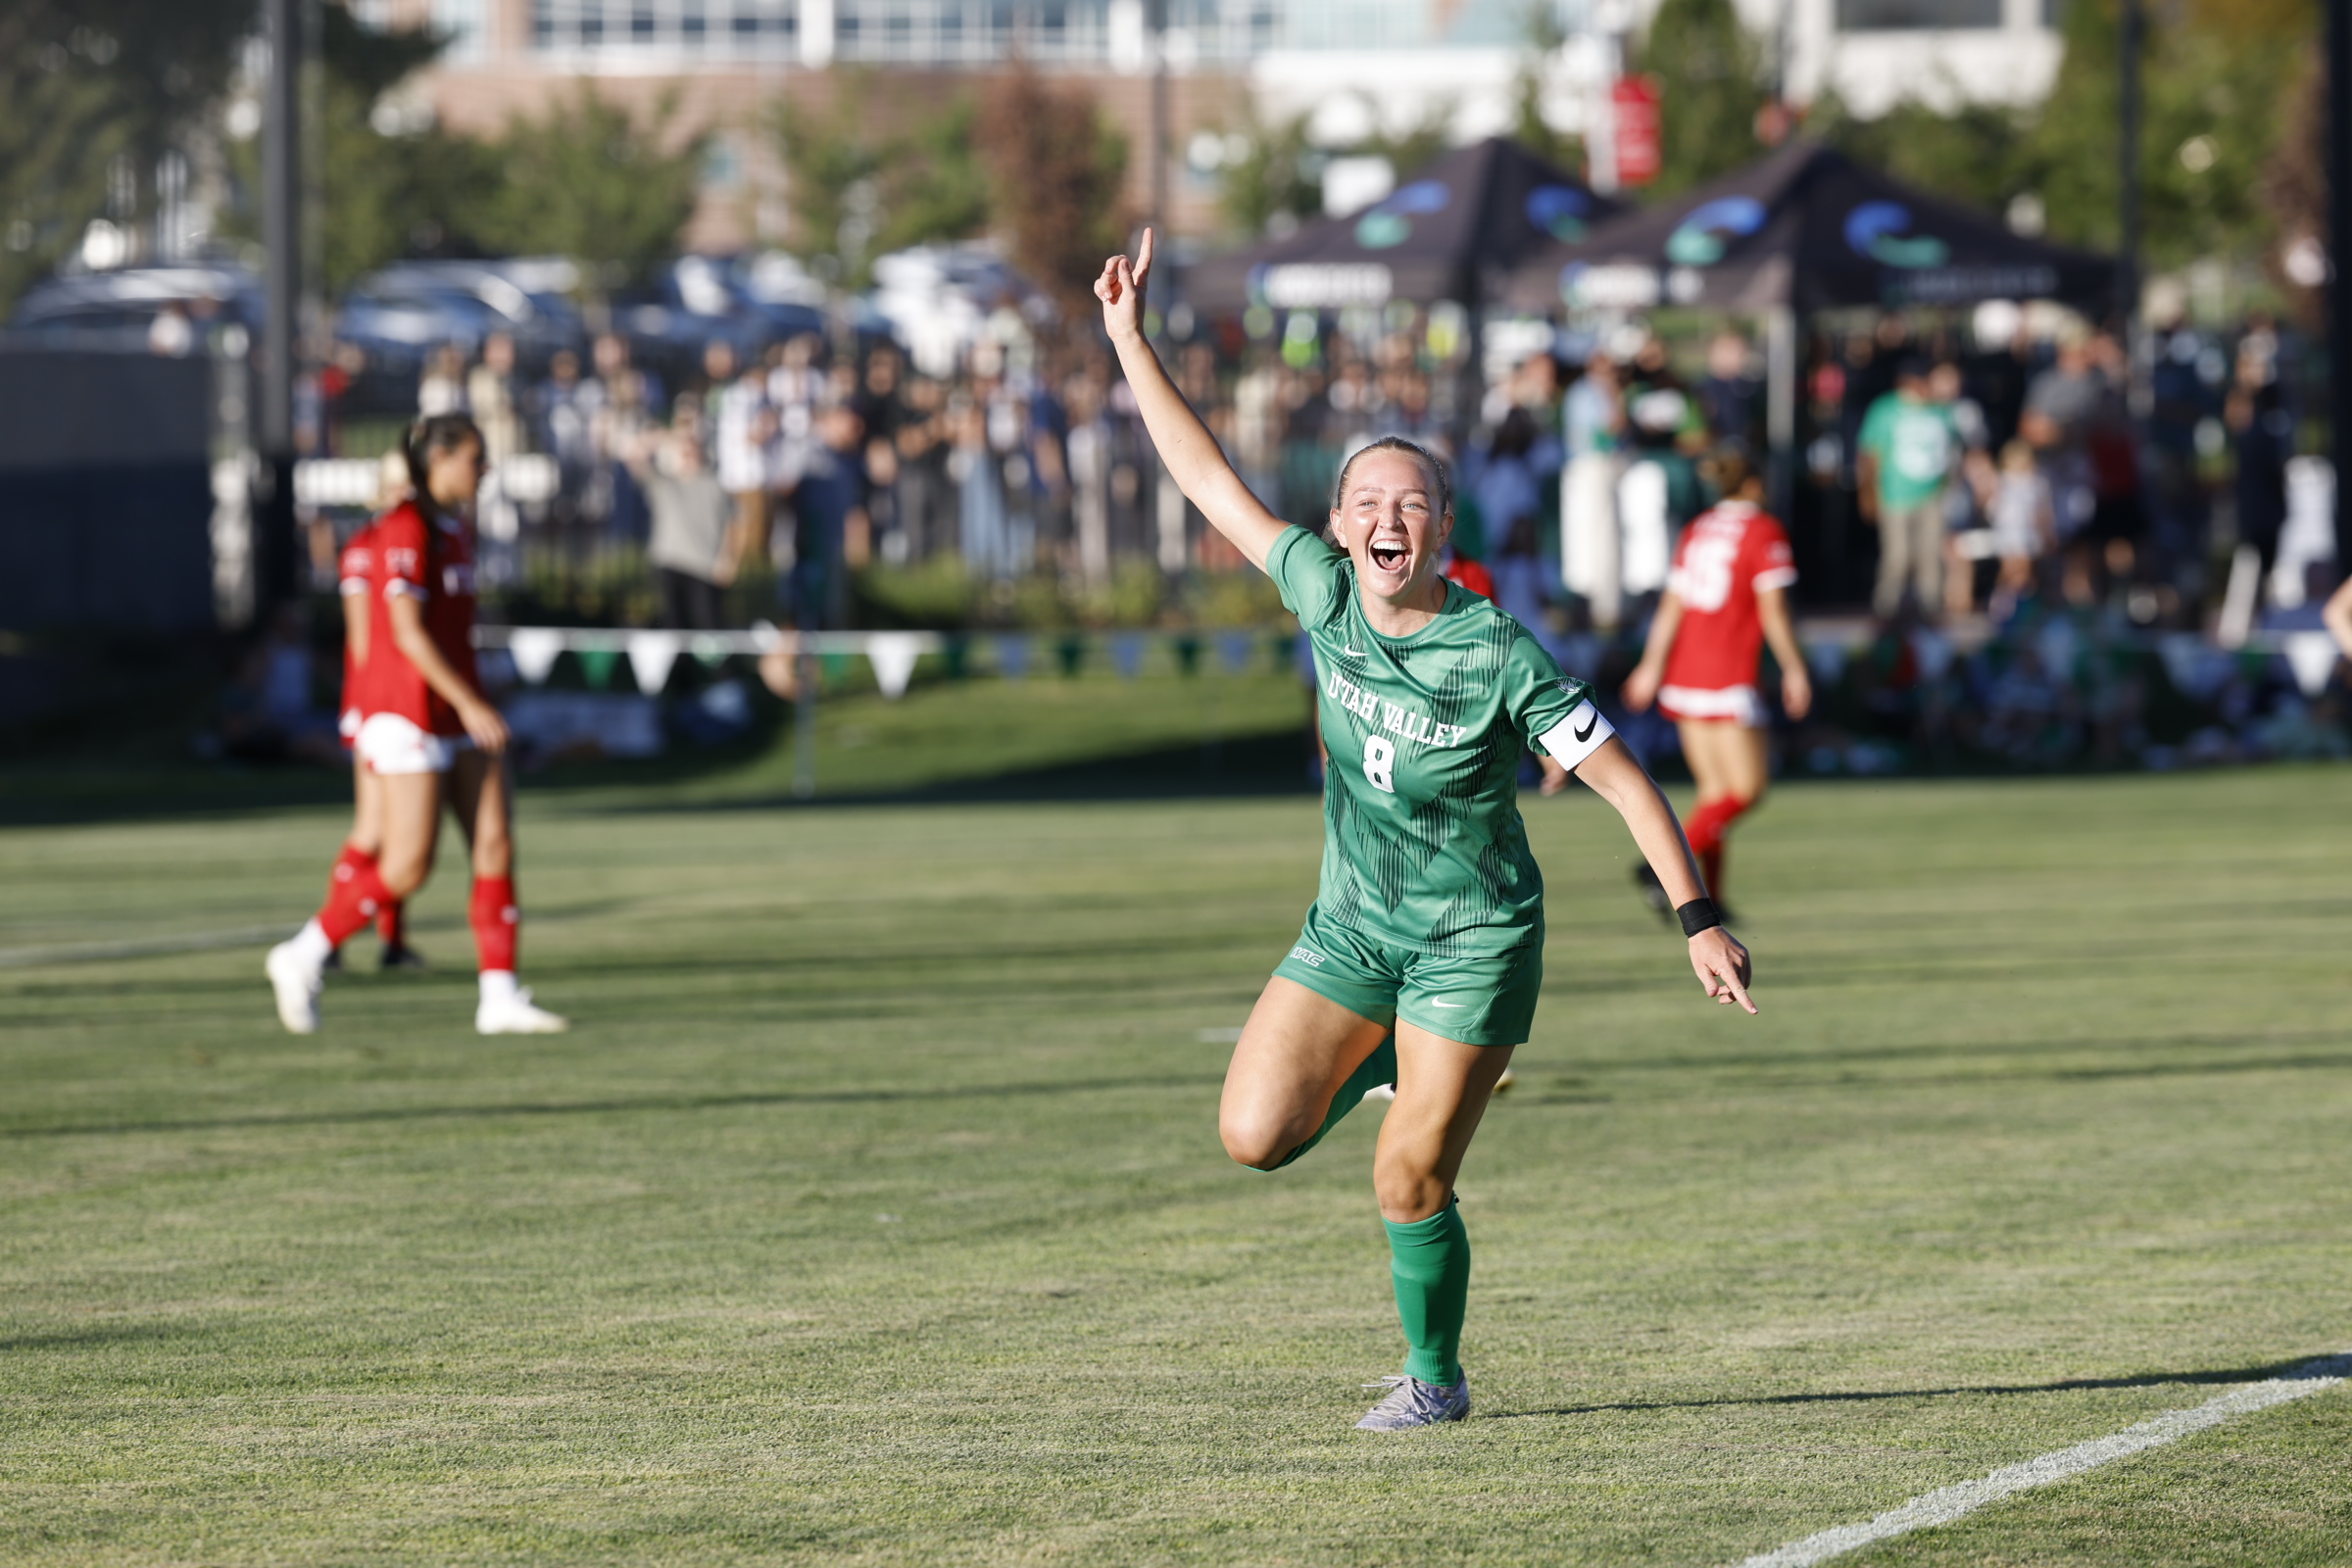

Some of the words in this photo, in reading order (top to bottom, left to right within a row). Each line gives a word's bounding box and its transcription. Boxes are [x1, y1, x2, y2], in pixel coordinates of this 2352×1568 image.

[1328, 671, 1379, 721] UTAH
[1383, 702, 1467, 748] VALLEY
[1363, 734, 1396, 794] 8
[1289, 946, 1326, 967] WAC
